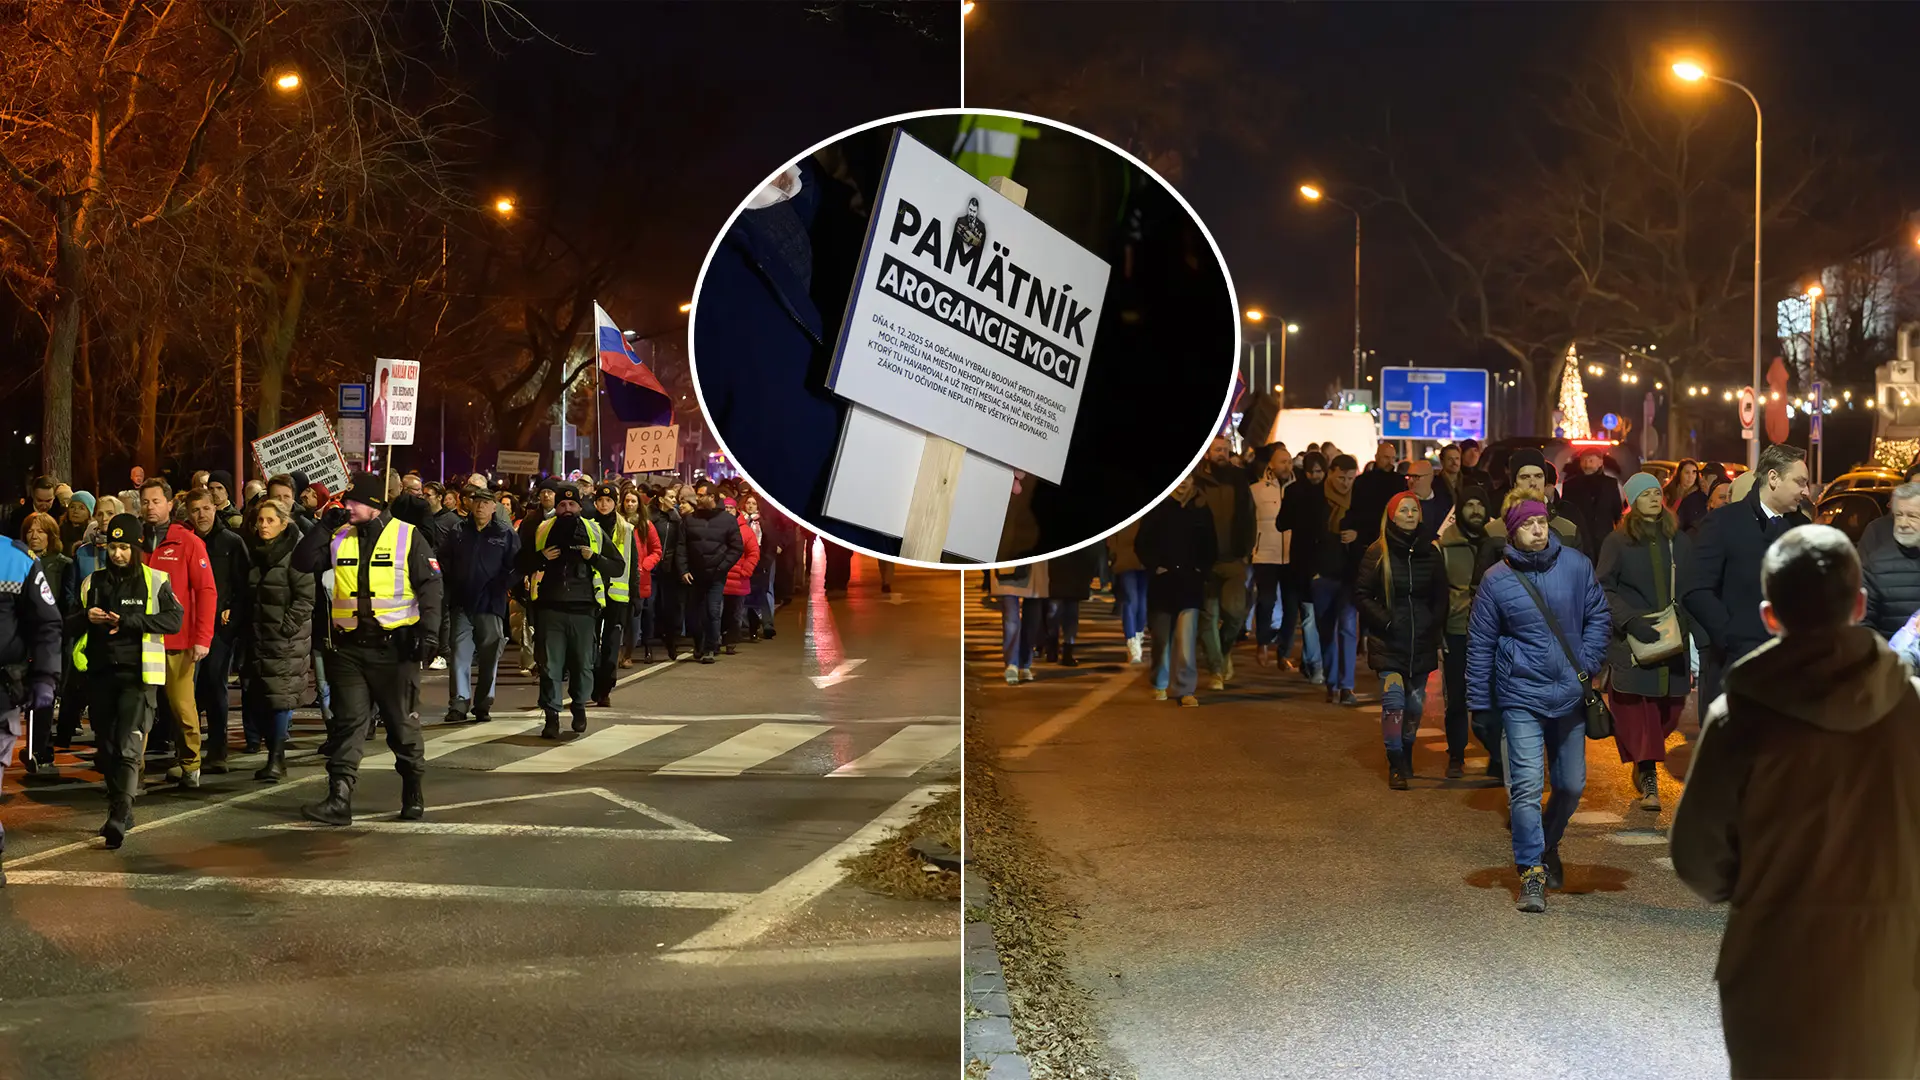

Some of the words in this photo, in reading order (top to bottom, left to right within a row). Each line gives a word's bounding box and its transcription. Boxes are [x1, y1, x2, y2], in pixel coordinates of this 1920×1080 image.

[890, 198, 1092, 348] PAMÄTNÍK
[871, 311, 889, 328] DŇA
[888, 321, 896, 331] 4.
[896, 325, 907, 337] 12.
[907, 330, 924, 345] 2025
[923, 338, 934, 350] SA
[933, 342, 965, 364] OBČANIA
[964, 358, 991, 377] VYBRALI
[990, 370, 1018, 390] BOJOVAŤ
[1018, 384, 1036, 399] PROTI
[1035, 393, 1066, 413] AROGANCII
[880, 264, 1020, 354] AROGANCIE
[1021, 335, 1076, 383] MOCI
[867, 337, 892, 357] KTORÝ
[892, 350, 902, 362] TU
[903, 355, 944, 381] HAVAROVAL
[943, 375, 950, 383] A
[949, 375, 960, 388] UŽ
[959, 380, 979, 397] TRETÍ
[978, 390, 1001, 407] MESIAC
[1001, 401, 1010, 411] SA
[1010, 403, 1022, 416] NIČ
[1021, 409, 1060, 434] NEVYŠETRILO.
[877, 355, 903, 375] ZÁKON
[903, 368, 914, 380] TU
[913, 372, 948, 395] OČIVIDNE
[947, 387, 975, 408] NEPLATÍ
[974, 401, 987, 413] PRE
[986, 405, 1018, 427] VŠETKÝCH
[1018, 421, 1048, 440] ROVNAKO.
[898, 338, 921, 356] PRIŠLI
[921, 350, 932, 362] NA
[932, 355, 958, 374] MIESTO
[957, 368, 985, 387] NEHODY
[984, 381, 1004, 396] PAVLA
[1004, 388, 1033, 410] GAŠPARA,
[1032, 402, 1047, 416] ŠÉFA
[626, 453, 672, 469] VARÍ
[629, 429, 675, 442] VODA
[640, 444, 660, 456] SA
